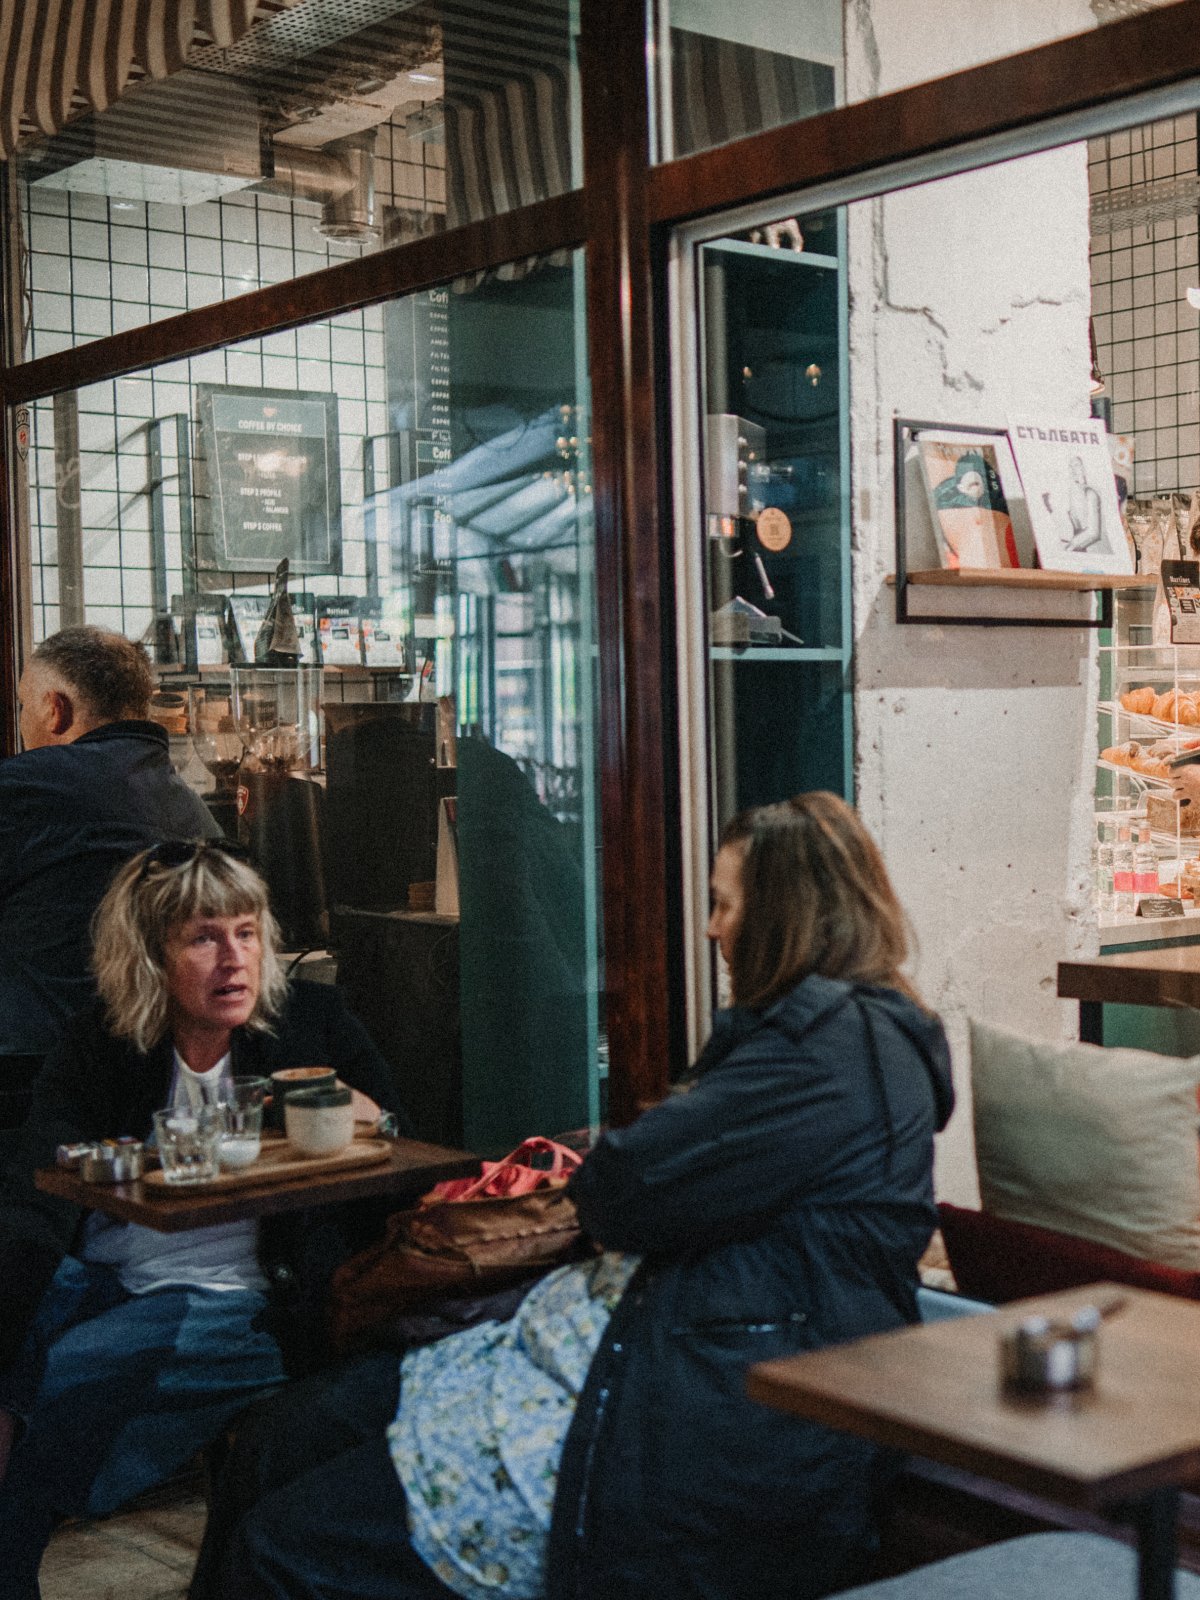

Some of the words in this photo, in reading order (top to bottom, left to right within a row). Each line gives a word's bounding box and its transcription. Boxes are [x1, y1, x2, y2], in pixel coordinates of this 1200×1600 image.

[238, 420, 265, 431] COFFEE
[266, 421, 276, 432] BY
[276, 422, 303, 433] CHOICE
[1016, 425, 1100, 445] СТЪЛБАТА
